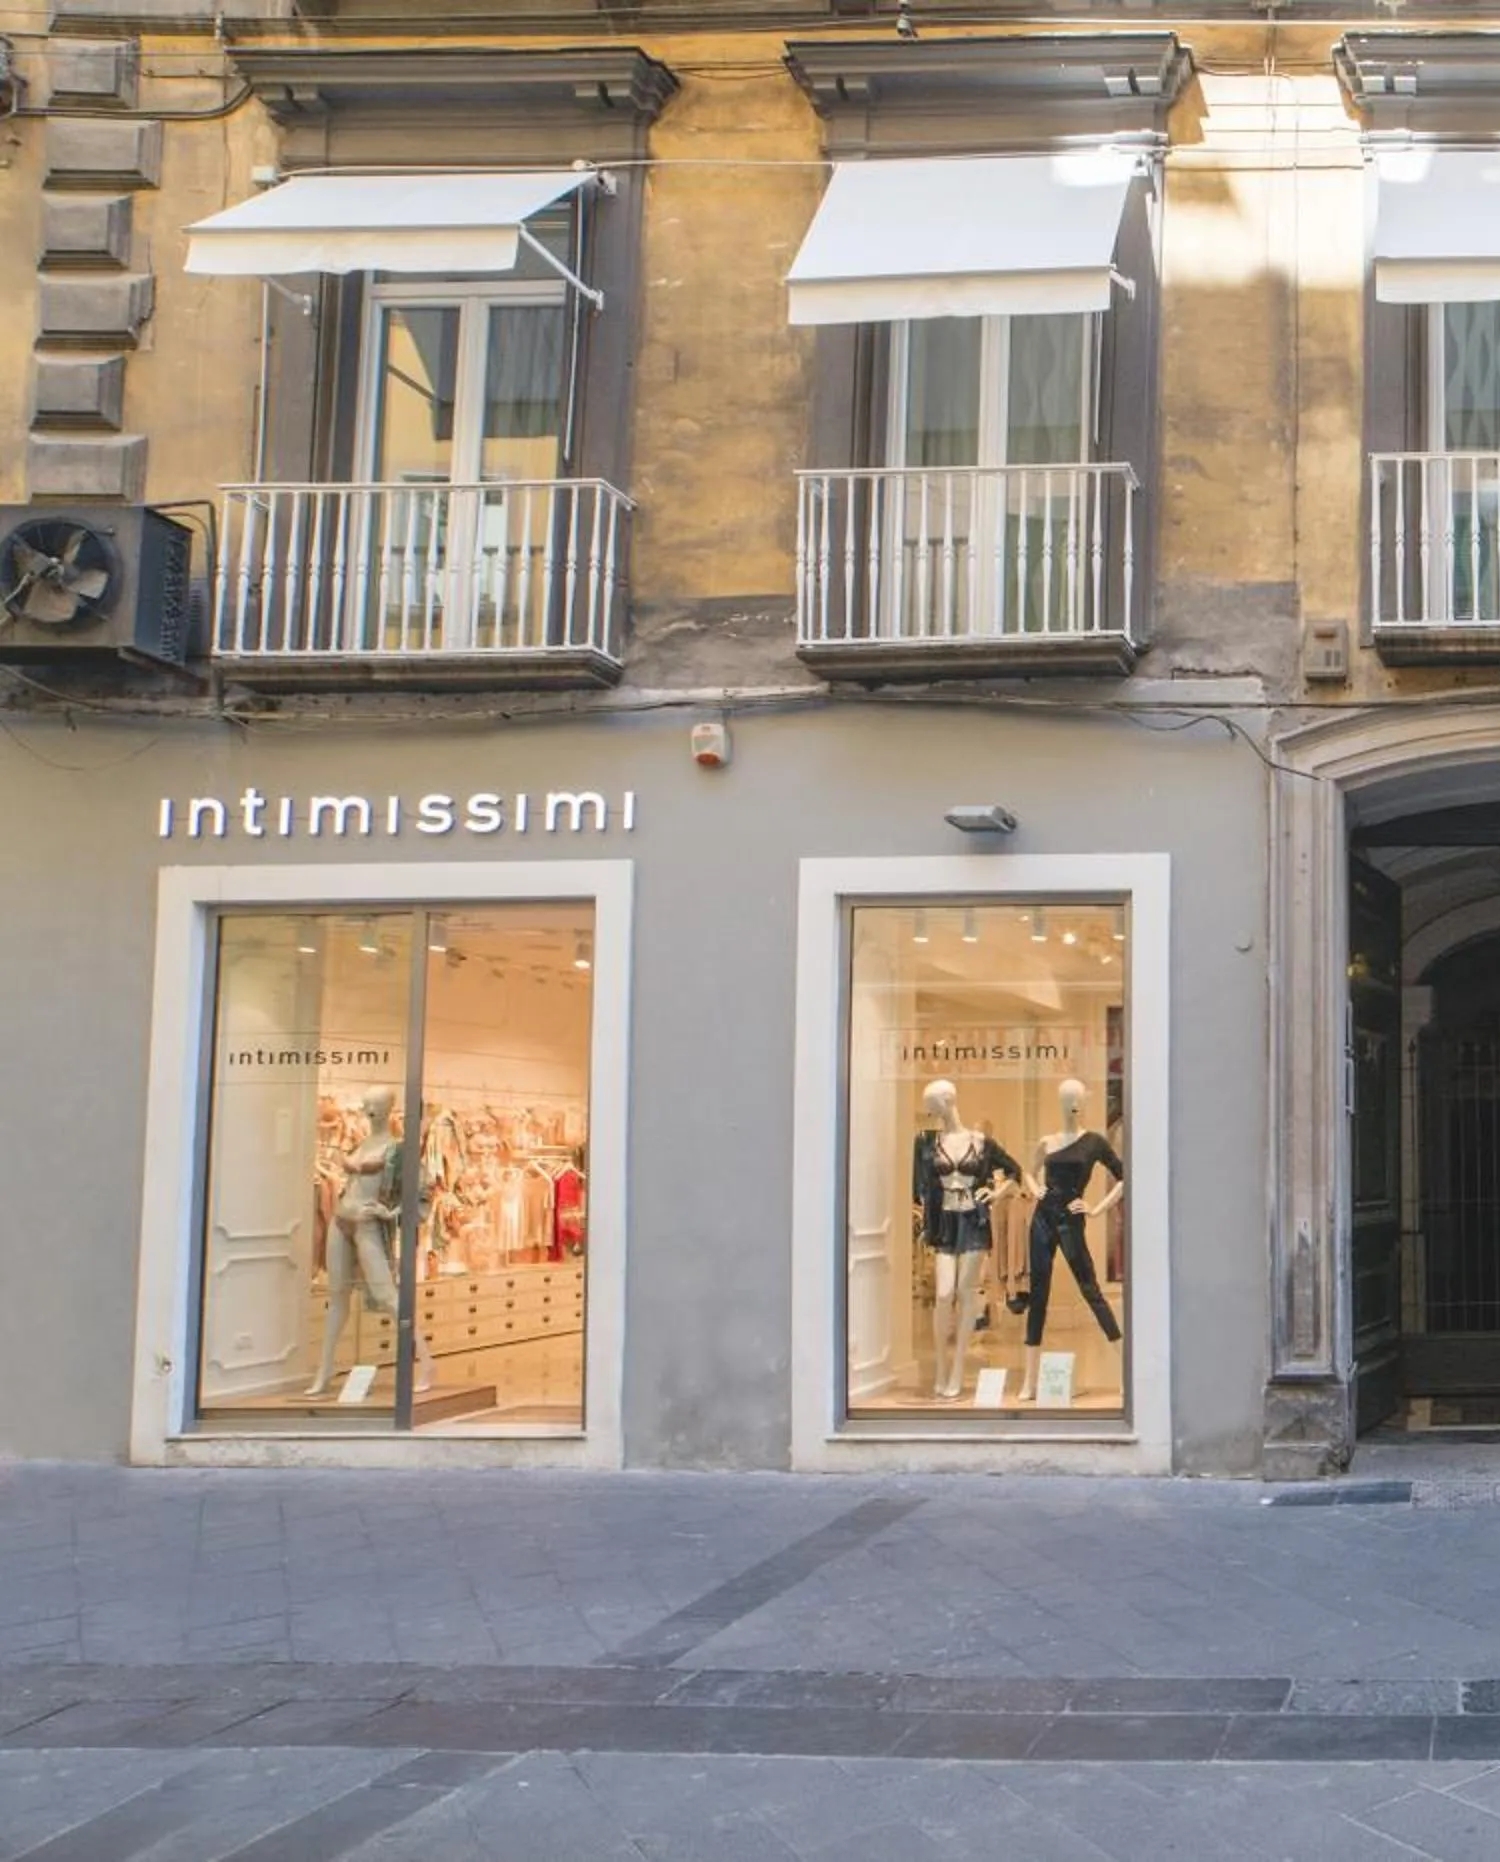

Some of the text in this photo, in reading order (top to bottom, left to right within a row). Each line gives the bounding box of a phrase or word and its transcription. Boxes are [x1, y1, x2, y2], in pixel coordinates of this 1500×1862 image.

[159, 787, 636, 837] intimissimi
[229, 1049, 389, 1065] intimissimi
[903, 1044, 1068, 1061] intimissimi
